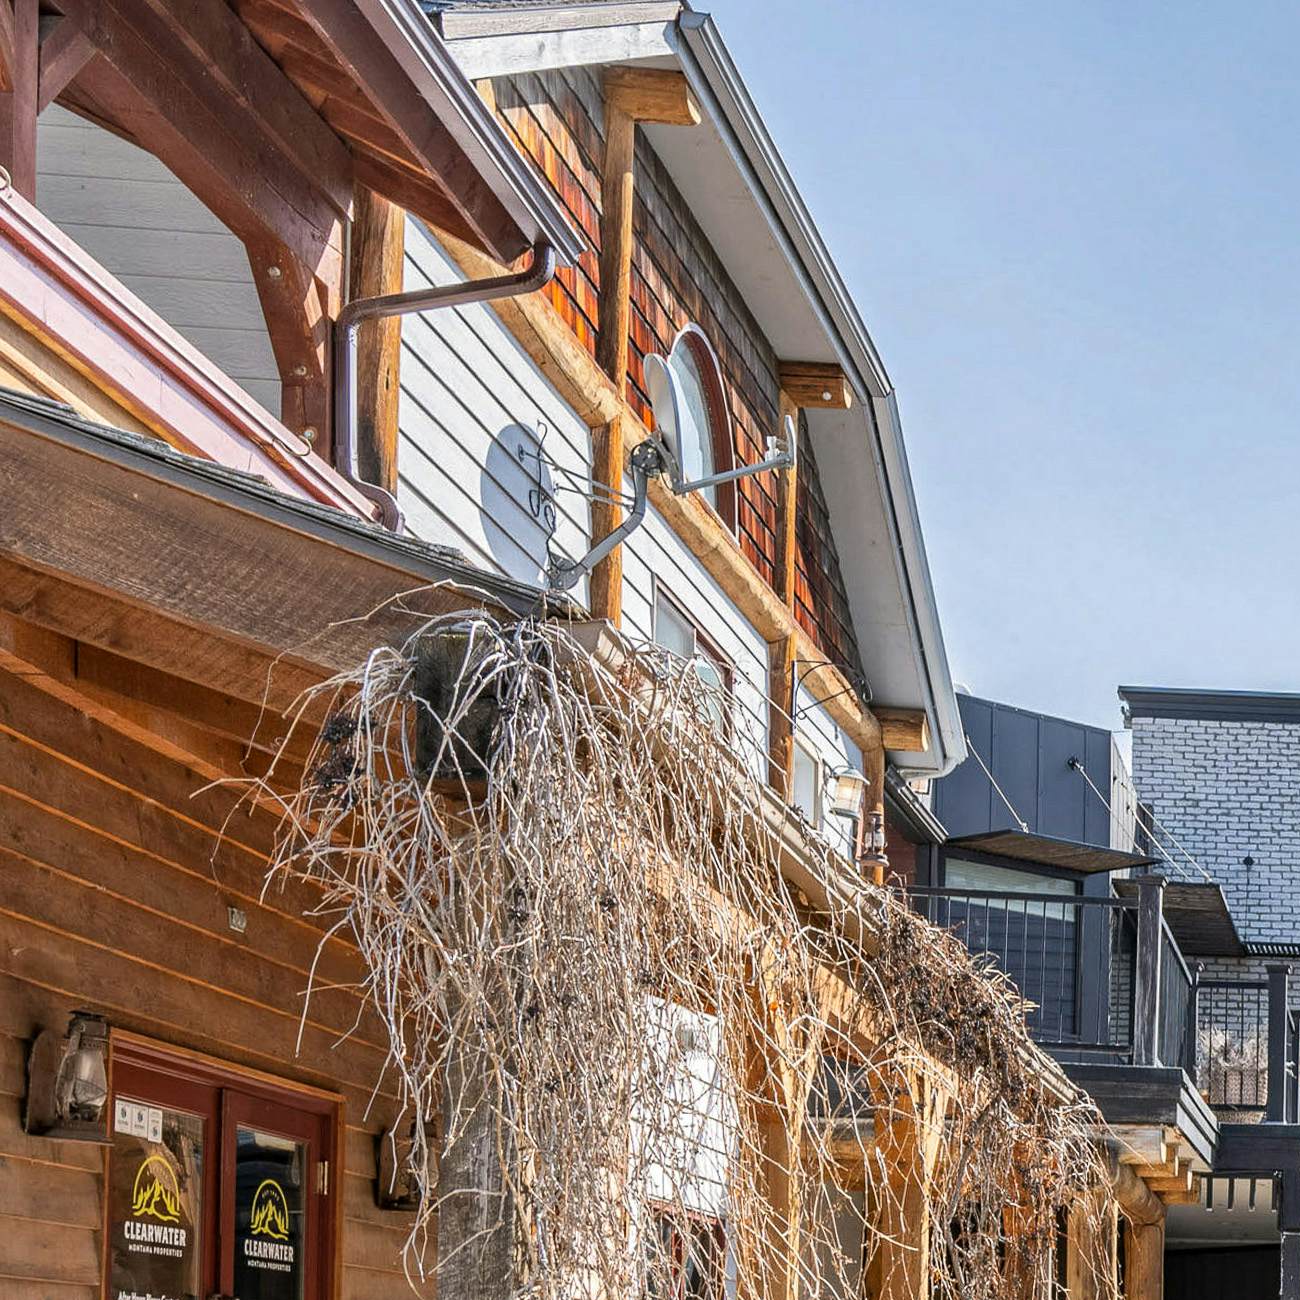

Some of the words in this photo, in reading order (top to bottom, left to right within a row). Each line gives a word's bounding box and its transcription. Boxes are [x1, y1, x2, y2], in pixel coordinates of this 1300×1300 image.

[124, 1220, 187, 1247] CLEARWATER
[128, 1244, 153, 1254] MONTANA
[153, 1247, 183, 1258] PROPERTIES
[244, 1239, 294, 1262] CLEARWATER
